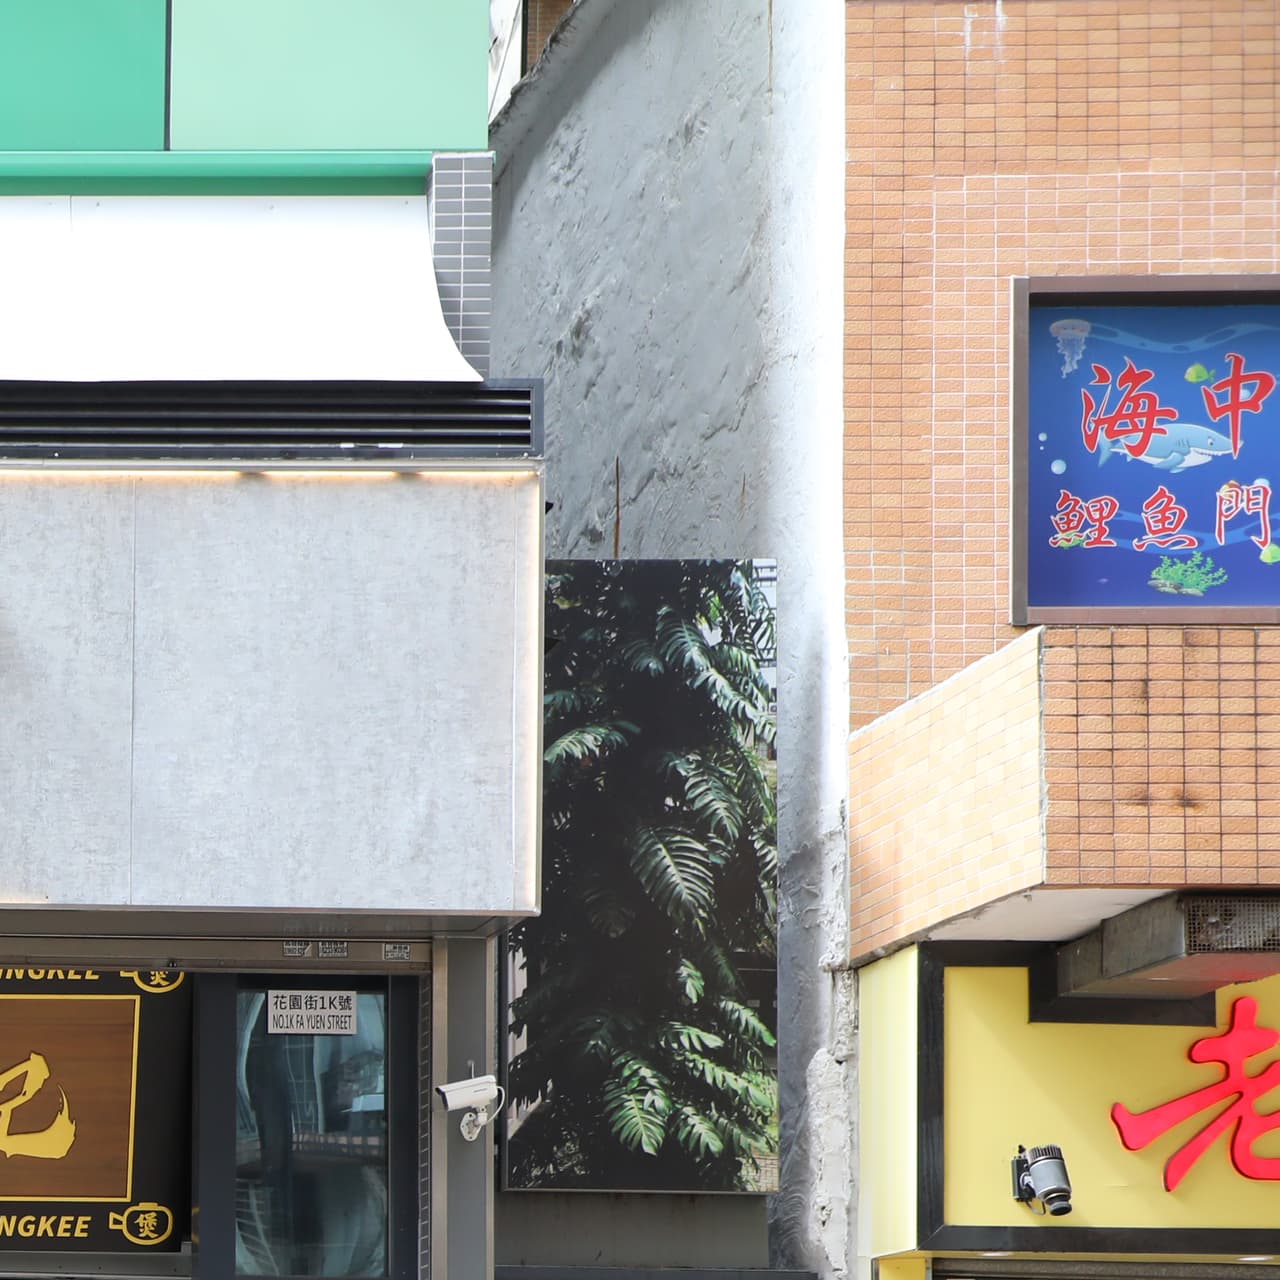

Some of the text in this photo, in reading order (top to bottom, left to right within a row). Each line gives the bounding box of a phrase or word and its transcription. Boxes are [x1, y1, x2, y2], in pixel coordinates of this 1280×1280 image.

[1080, 353, 1278, 458] 海中
[1048, 484, 1272, 552] 鯉魚門
[273, 994, 352, 1011] 花園街1K號
[273, 1014, 353, 1031] NO.1K FA YUEN STREET
[1110, 996, 1280, 1193] 老
